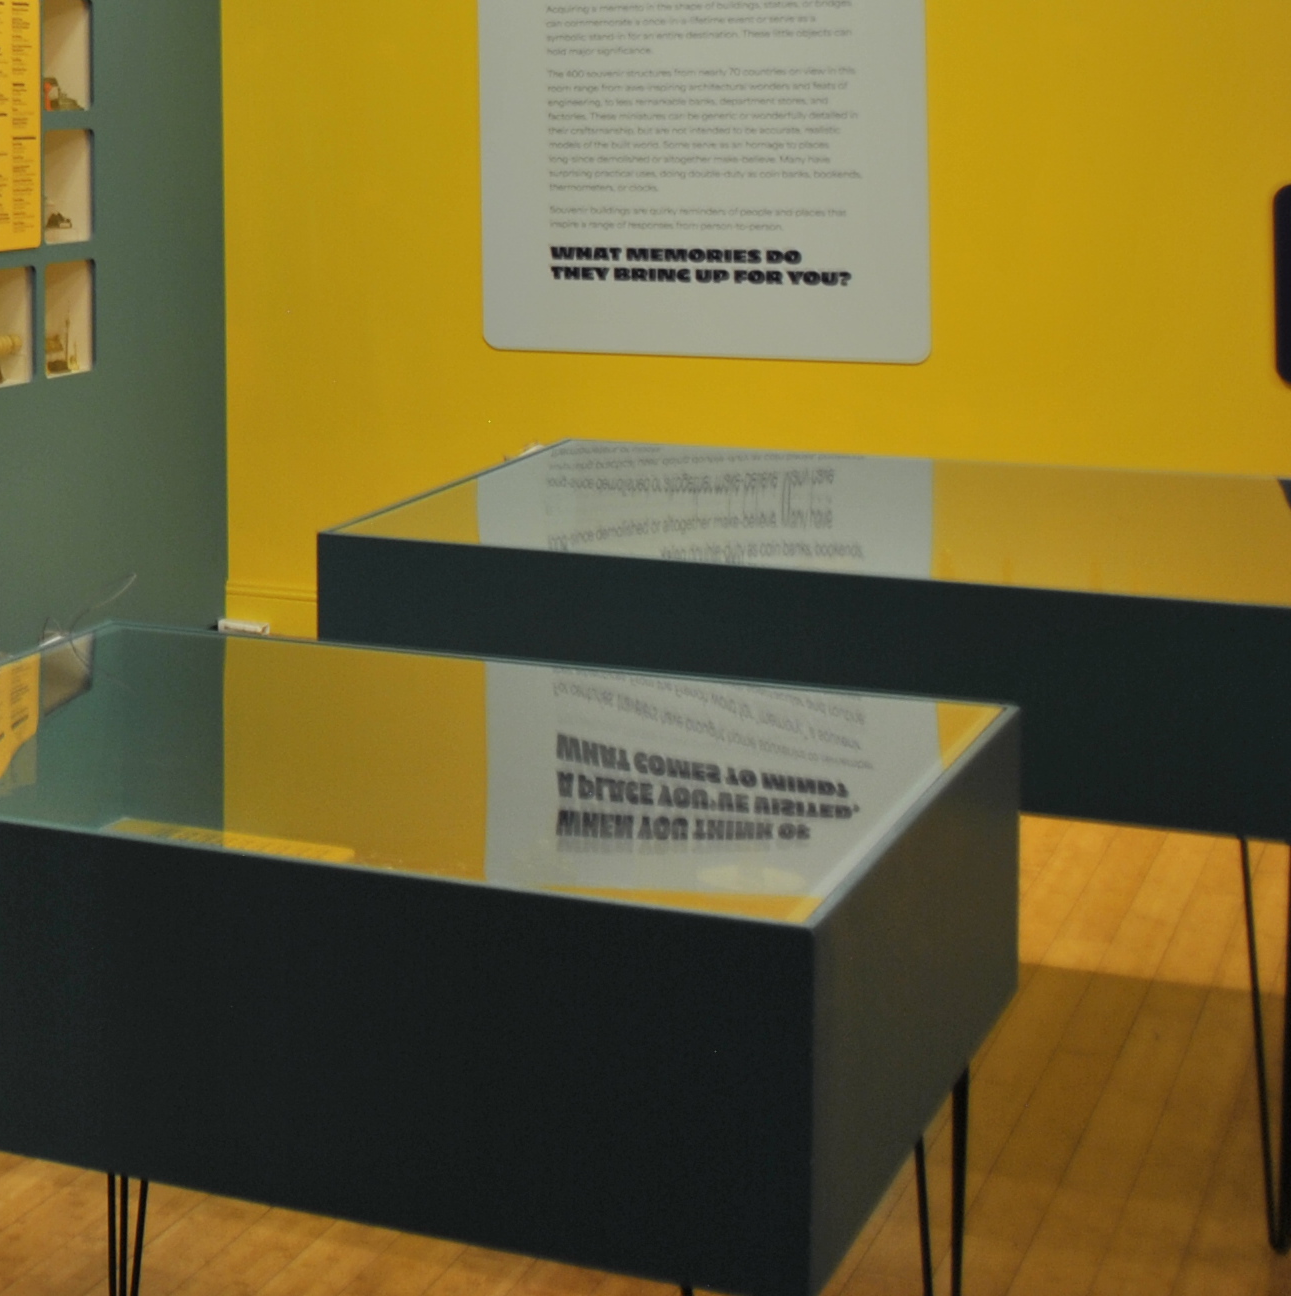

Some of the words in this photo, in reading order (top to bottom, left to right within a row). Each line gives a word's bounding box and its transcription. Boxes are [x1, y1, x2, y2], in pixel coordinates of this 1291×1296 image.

[549, 245, 622, 261] WHAT
[625, 246, 761, 264] MEMORIES
[765, 249, 802, 264] DO
[550, 265, 610, 280] THEY
[613, 266, 691, 283] BRING
[694, 268, 730, 283] UP
[733, 268, 783, 284] FOR
[786, 269, 851, 286] YOU?
